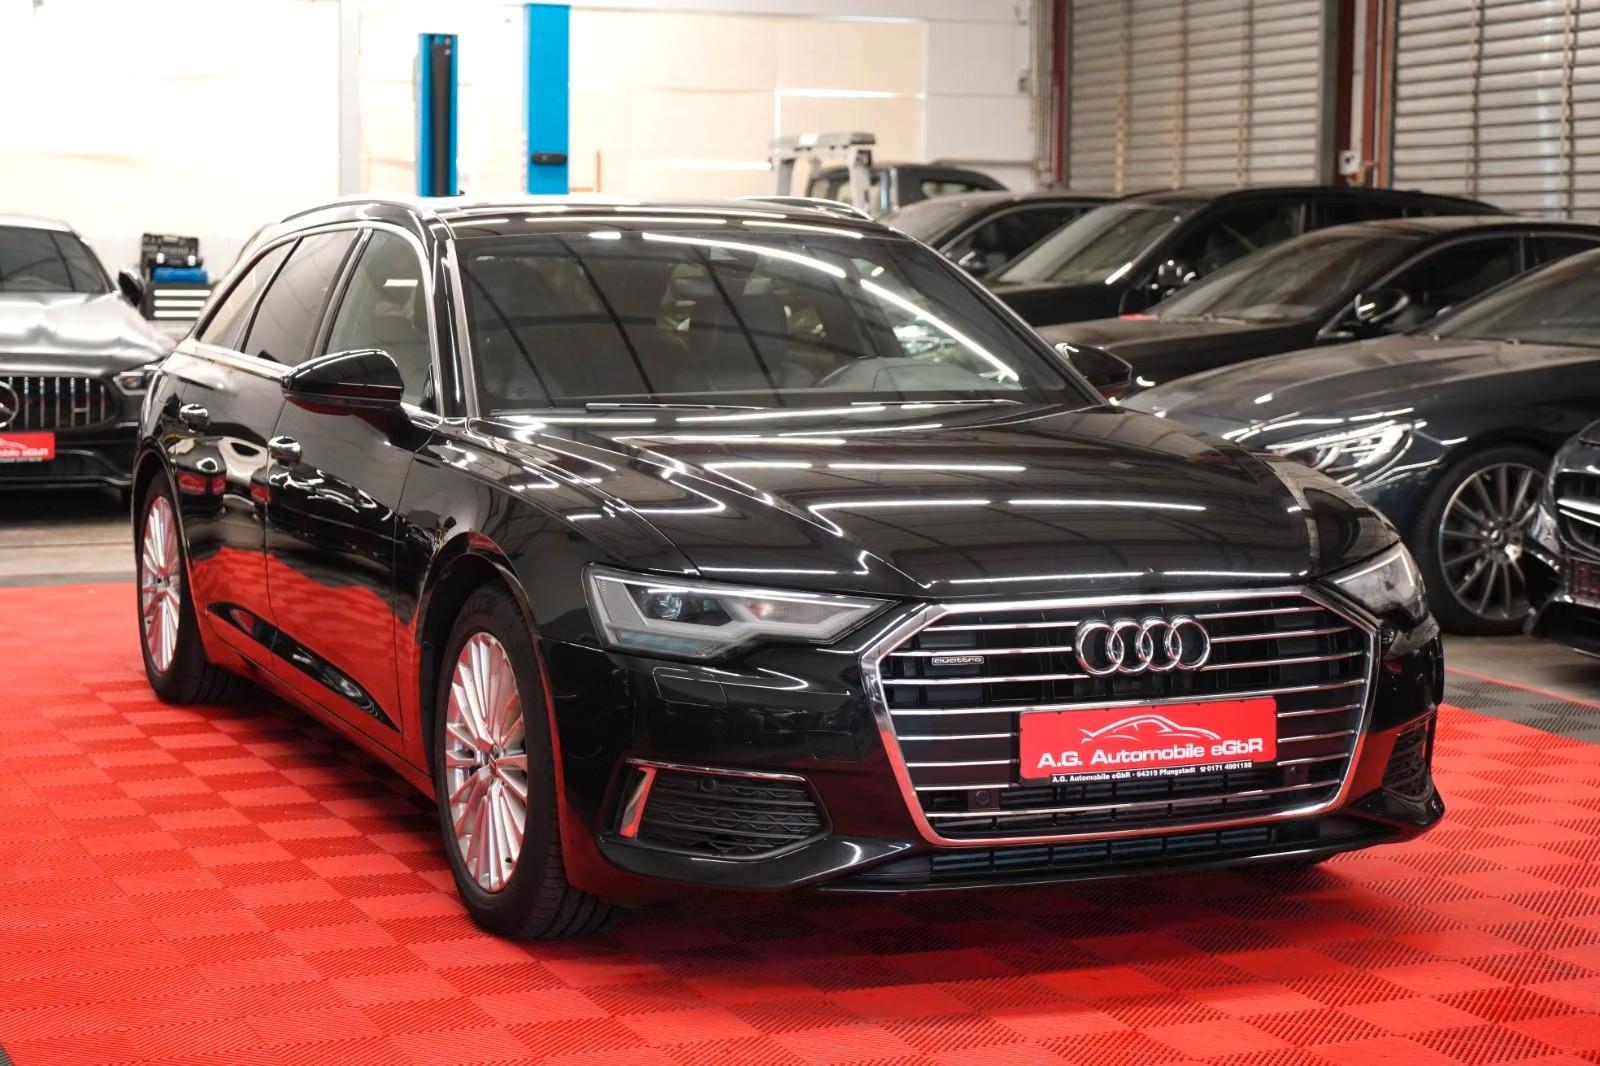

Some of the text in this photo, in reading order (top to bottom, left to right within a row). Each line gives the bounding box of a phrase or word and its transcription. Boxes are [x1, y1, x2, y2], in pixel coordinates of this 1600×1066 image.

[934, 656, 982, 664] quattro
[1037, 738, 1263, 768] A.G. Automobile eGbR
[1052, 775, 1068, 783] A.G.
[1069, 772, 1110, 782] Automobile
[1112, 771, 1131, 779] eGbR
[1206, 764, 1223, 772] 0171
